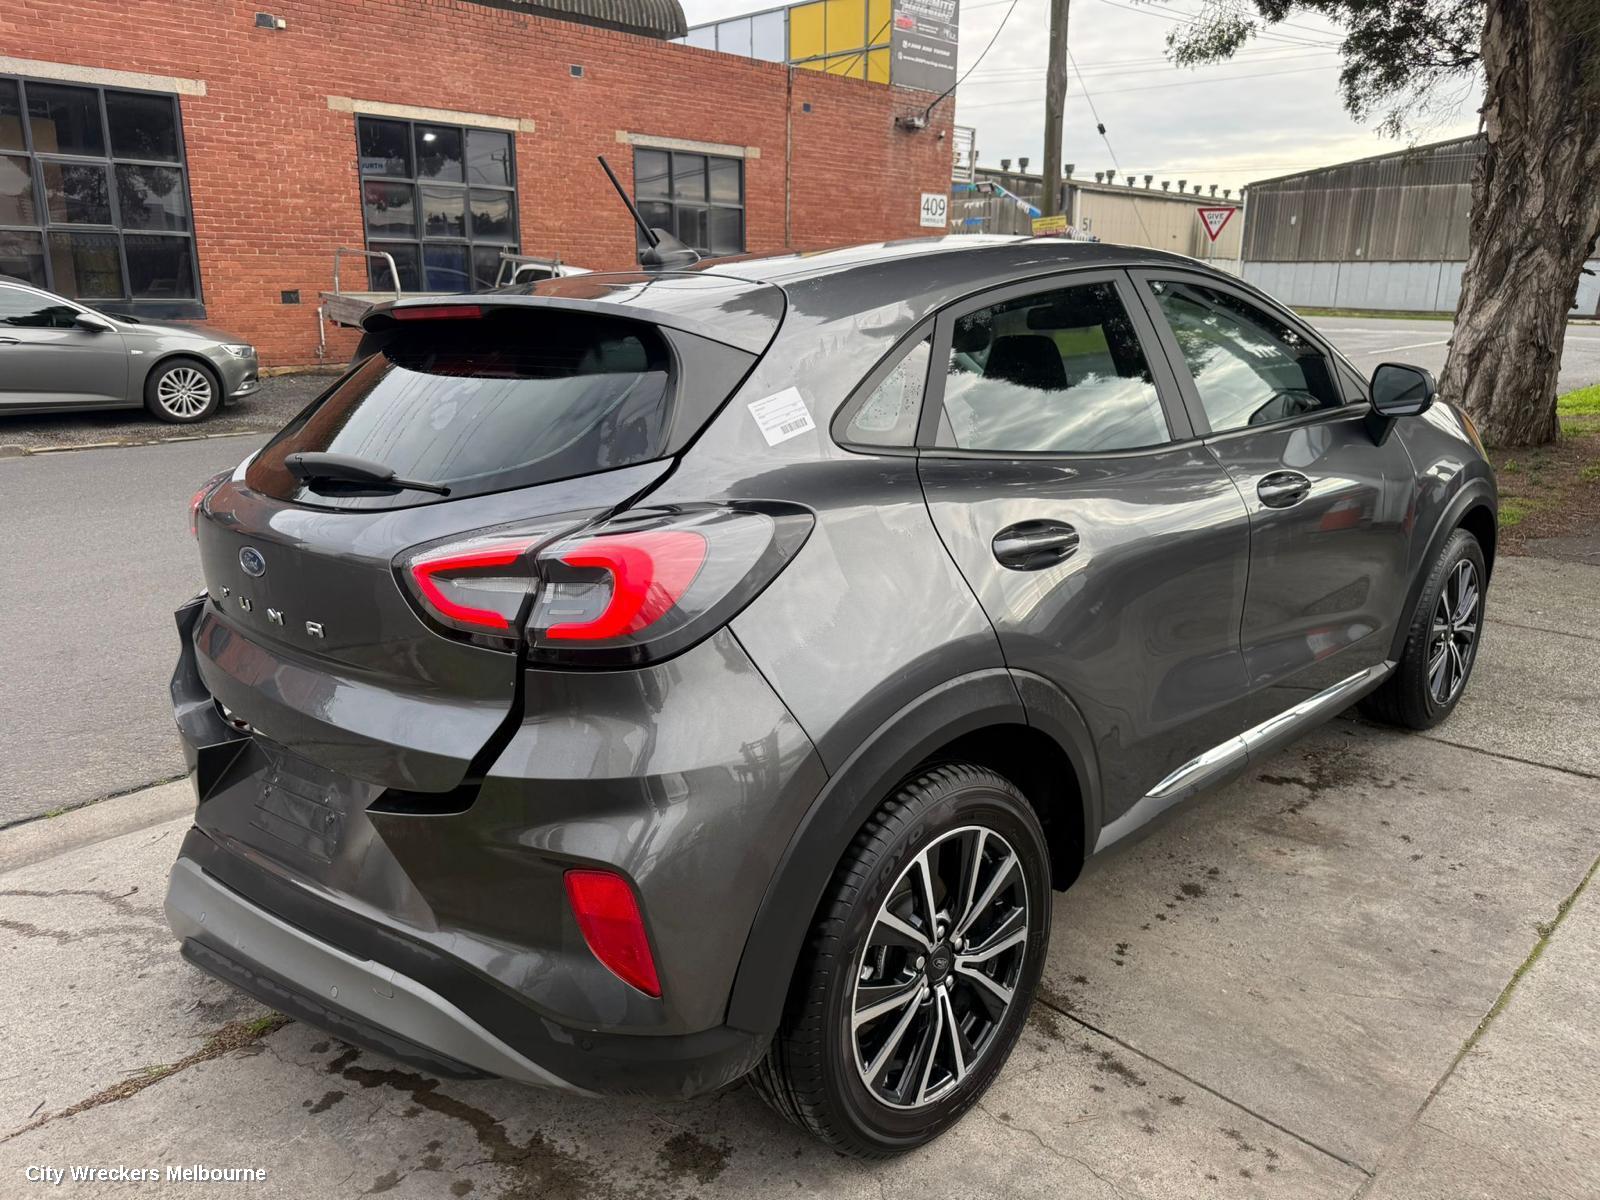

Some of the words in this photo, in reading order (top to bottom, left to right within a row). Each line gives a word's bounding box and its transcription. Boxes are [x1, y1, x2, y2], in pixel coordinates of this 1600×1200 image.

[922, 197, 946, 217] 409
[1082, 217, 1093, 231] 51
[220, 585, 326, 638] PUMA
